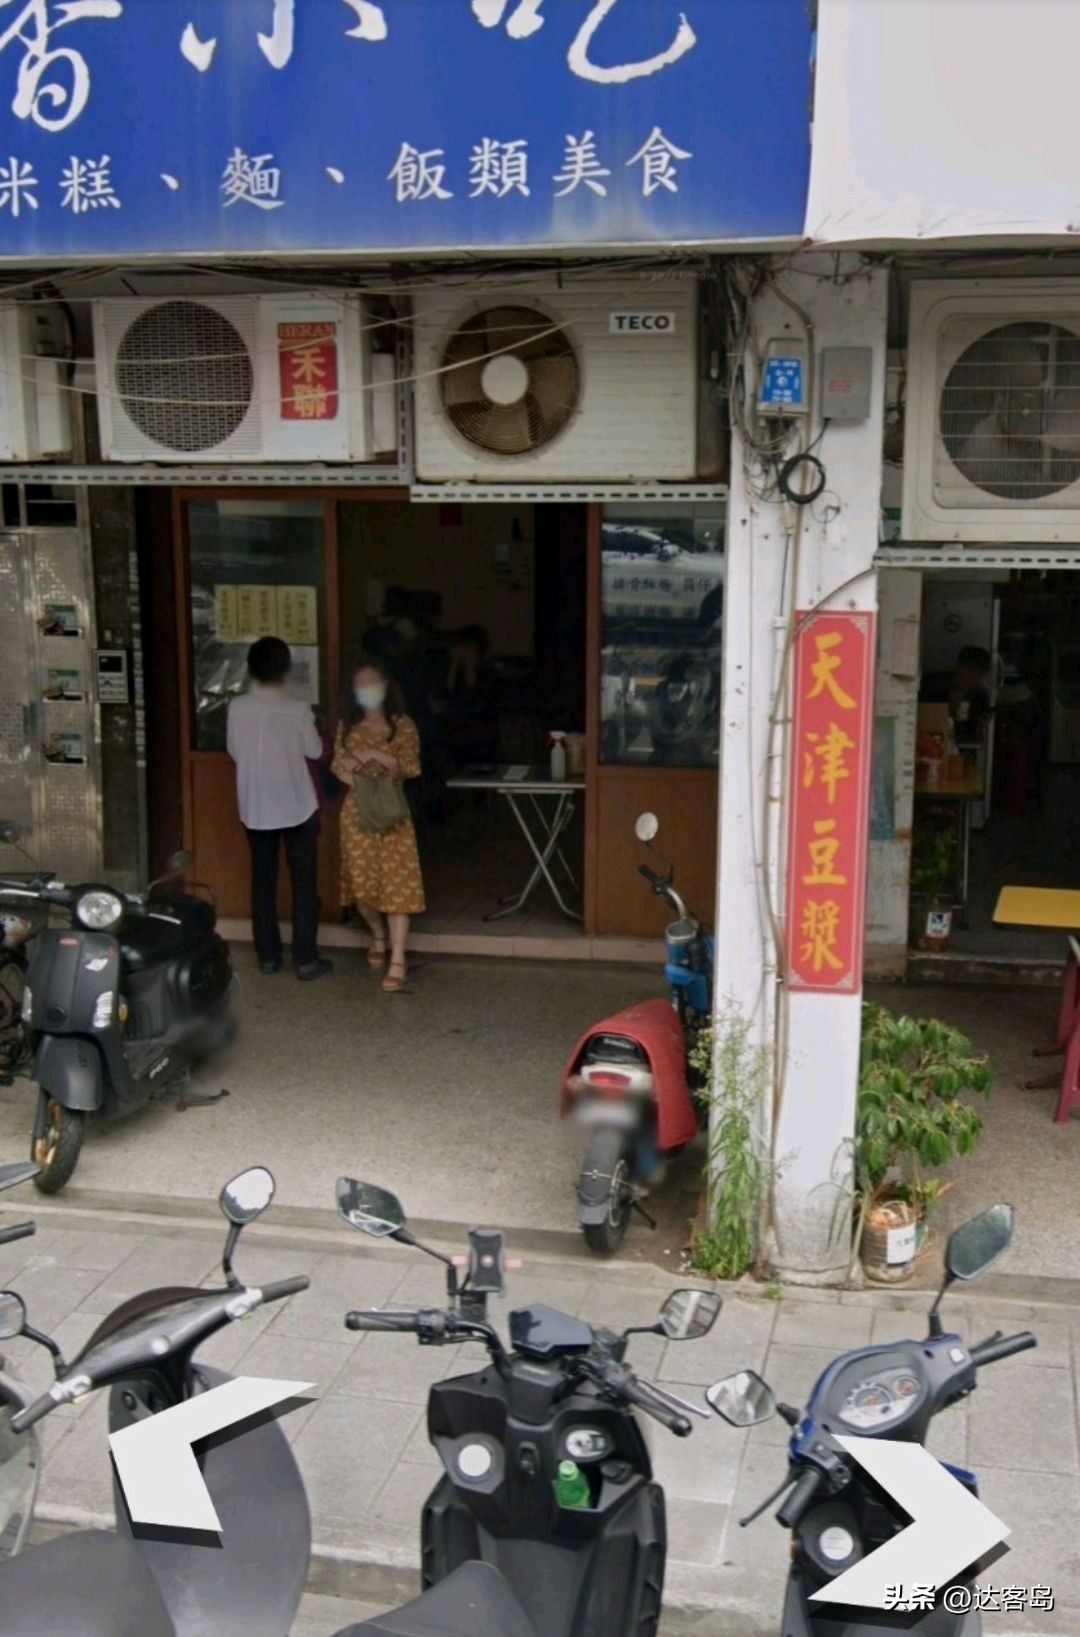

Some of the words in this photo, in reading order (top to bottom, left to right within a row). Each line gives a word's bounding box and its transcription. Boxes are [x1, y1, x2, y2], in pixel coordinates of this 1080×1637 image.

[615, 315, 670, 330] TECO
[802, 631, 857, 972] 天津豆漿
